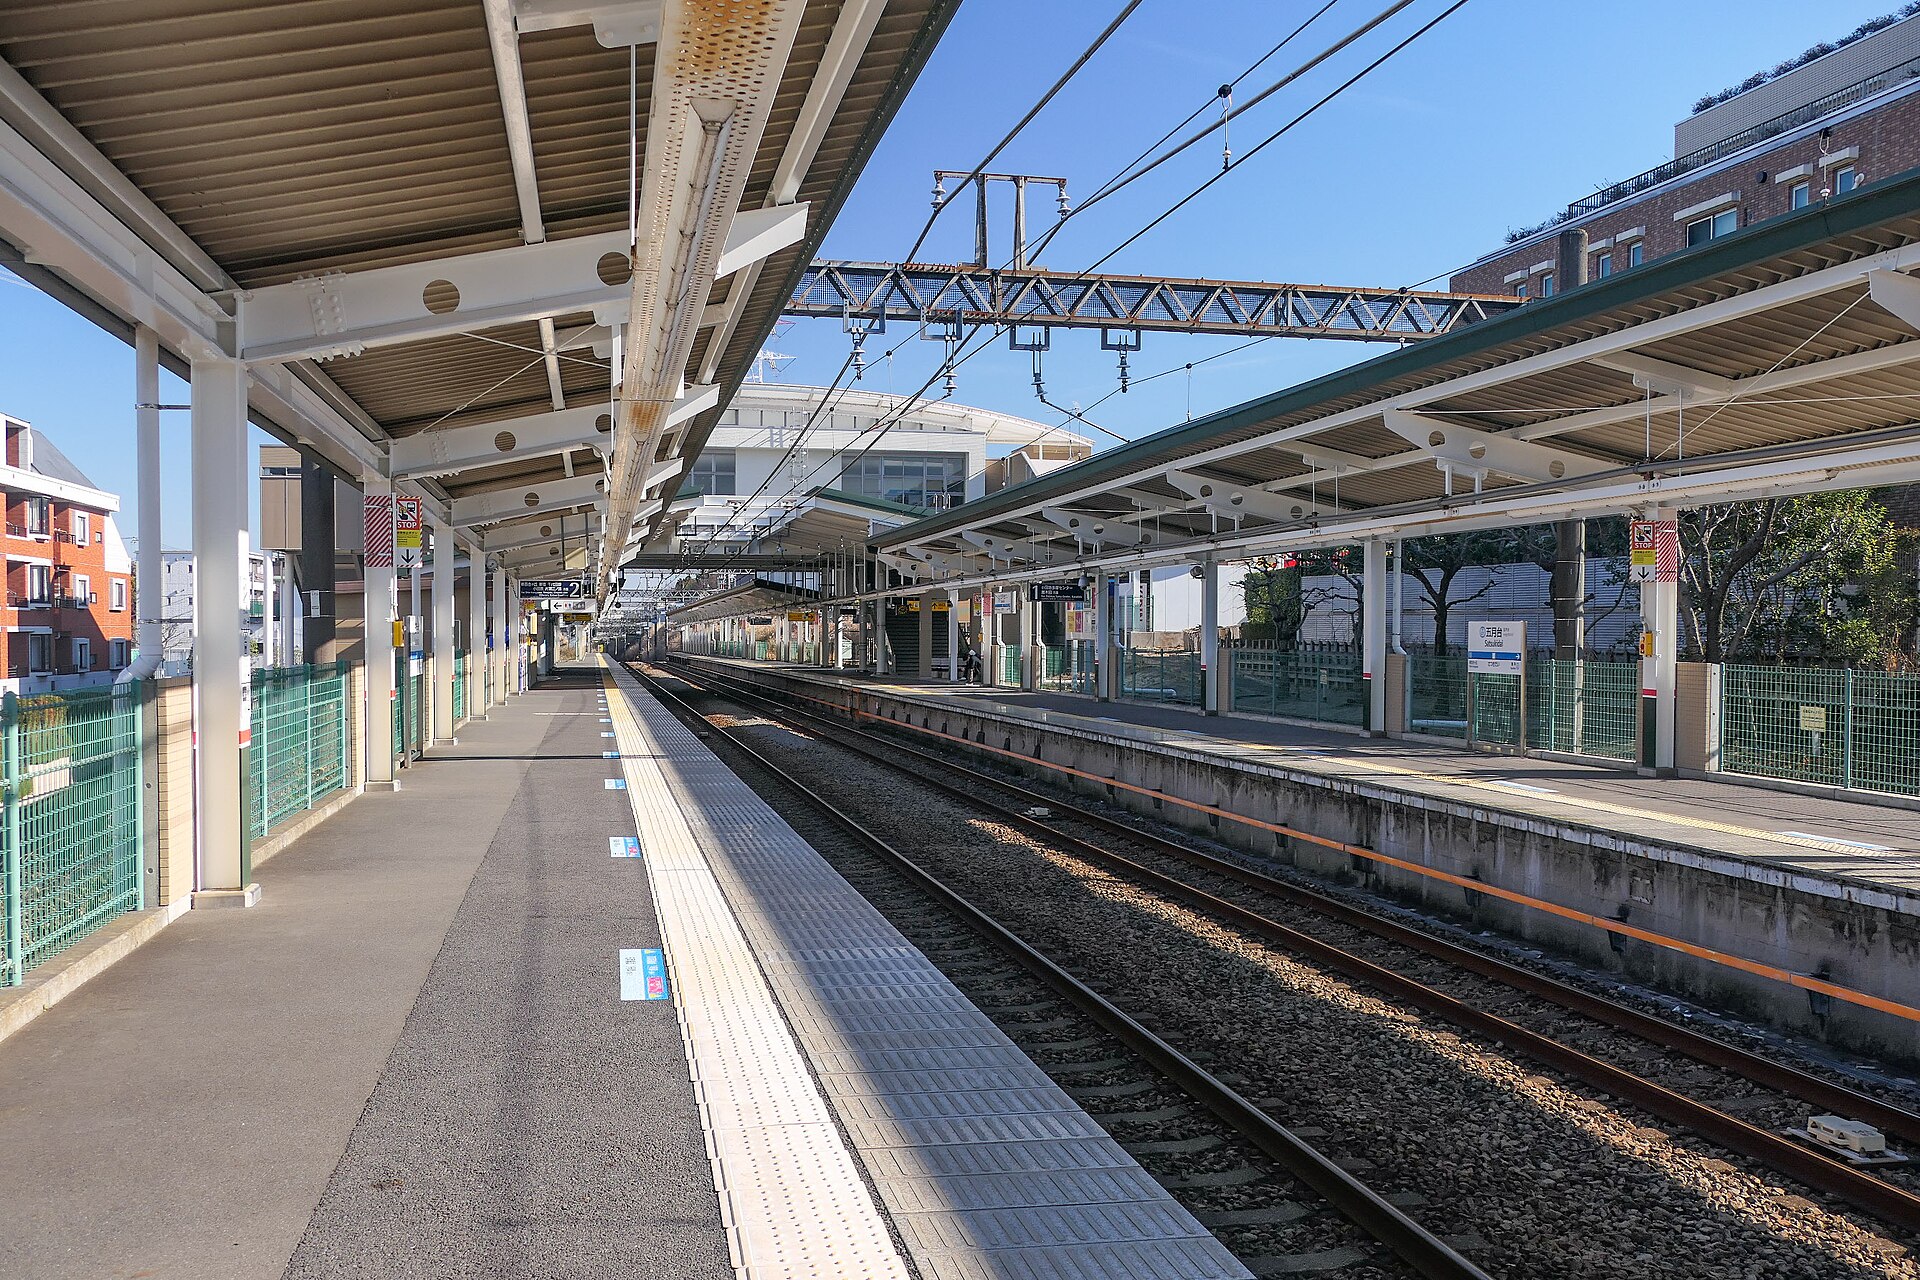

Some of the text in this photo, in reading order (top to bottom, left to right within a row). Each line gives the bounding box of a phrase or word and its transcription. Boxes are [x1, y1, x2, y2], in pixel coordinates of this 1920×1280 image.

[397, 521, 417, 529] STOP
[569, 582, 580, 598] 2
[1032, 585, 1038, 600] 1
[1486, 627, 1502, 638] 五月台
